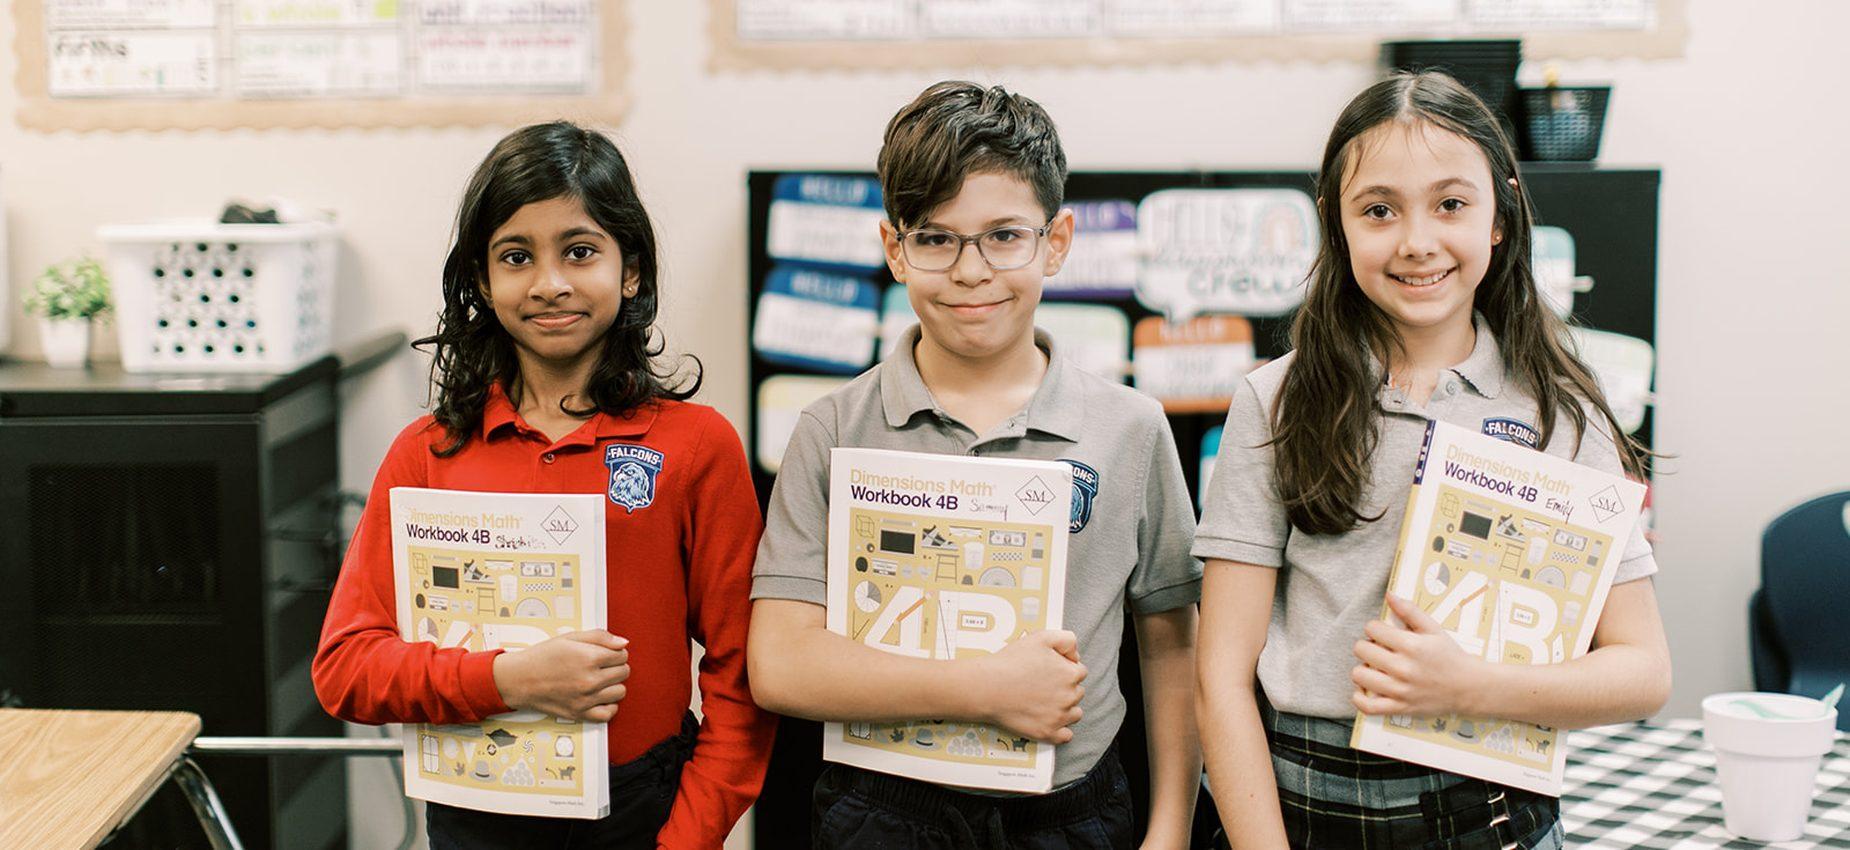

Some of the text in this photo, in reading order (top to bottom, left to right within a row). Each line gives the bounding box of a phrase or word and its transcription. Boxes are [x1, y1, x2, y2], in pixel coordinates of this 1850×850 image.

[1488, 422, 1536, 444] FALCONS
[610, 447, 660, 465] FALCONS
[1446, 444, 1531, 485] Dimensions
[1533, 470, 1572, 496] Math
[850, 468, 993, 497] Dimensions Math
[1444, 460, 1539, 503] Workbook 4B
[850, 484, 959, 511] Workbook 4B
[1023, 489, 1047, 503] SM
[481, 512, 521, 529] Math
[1544, 497, 1575, 525] Emily
[406, 523, 491, 544] Workbook 4B
[550, 519, 570, 532] SM
